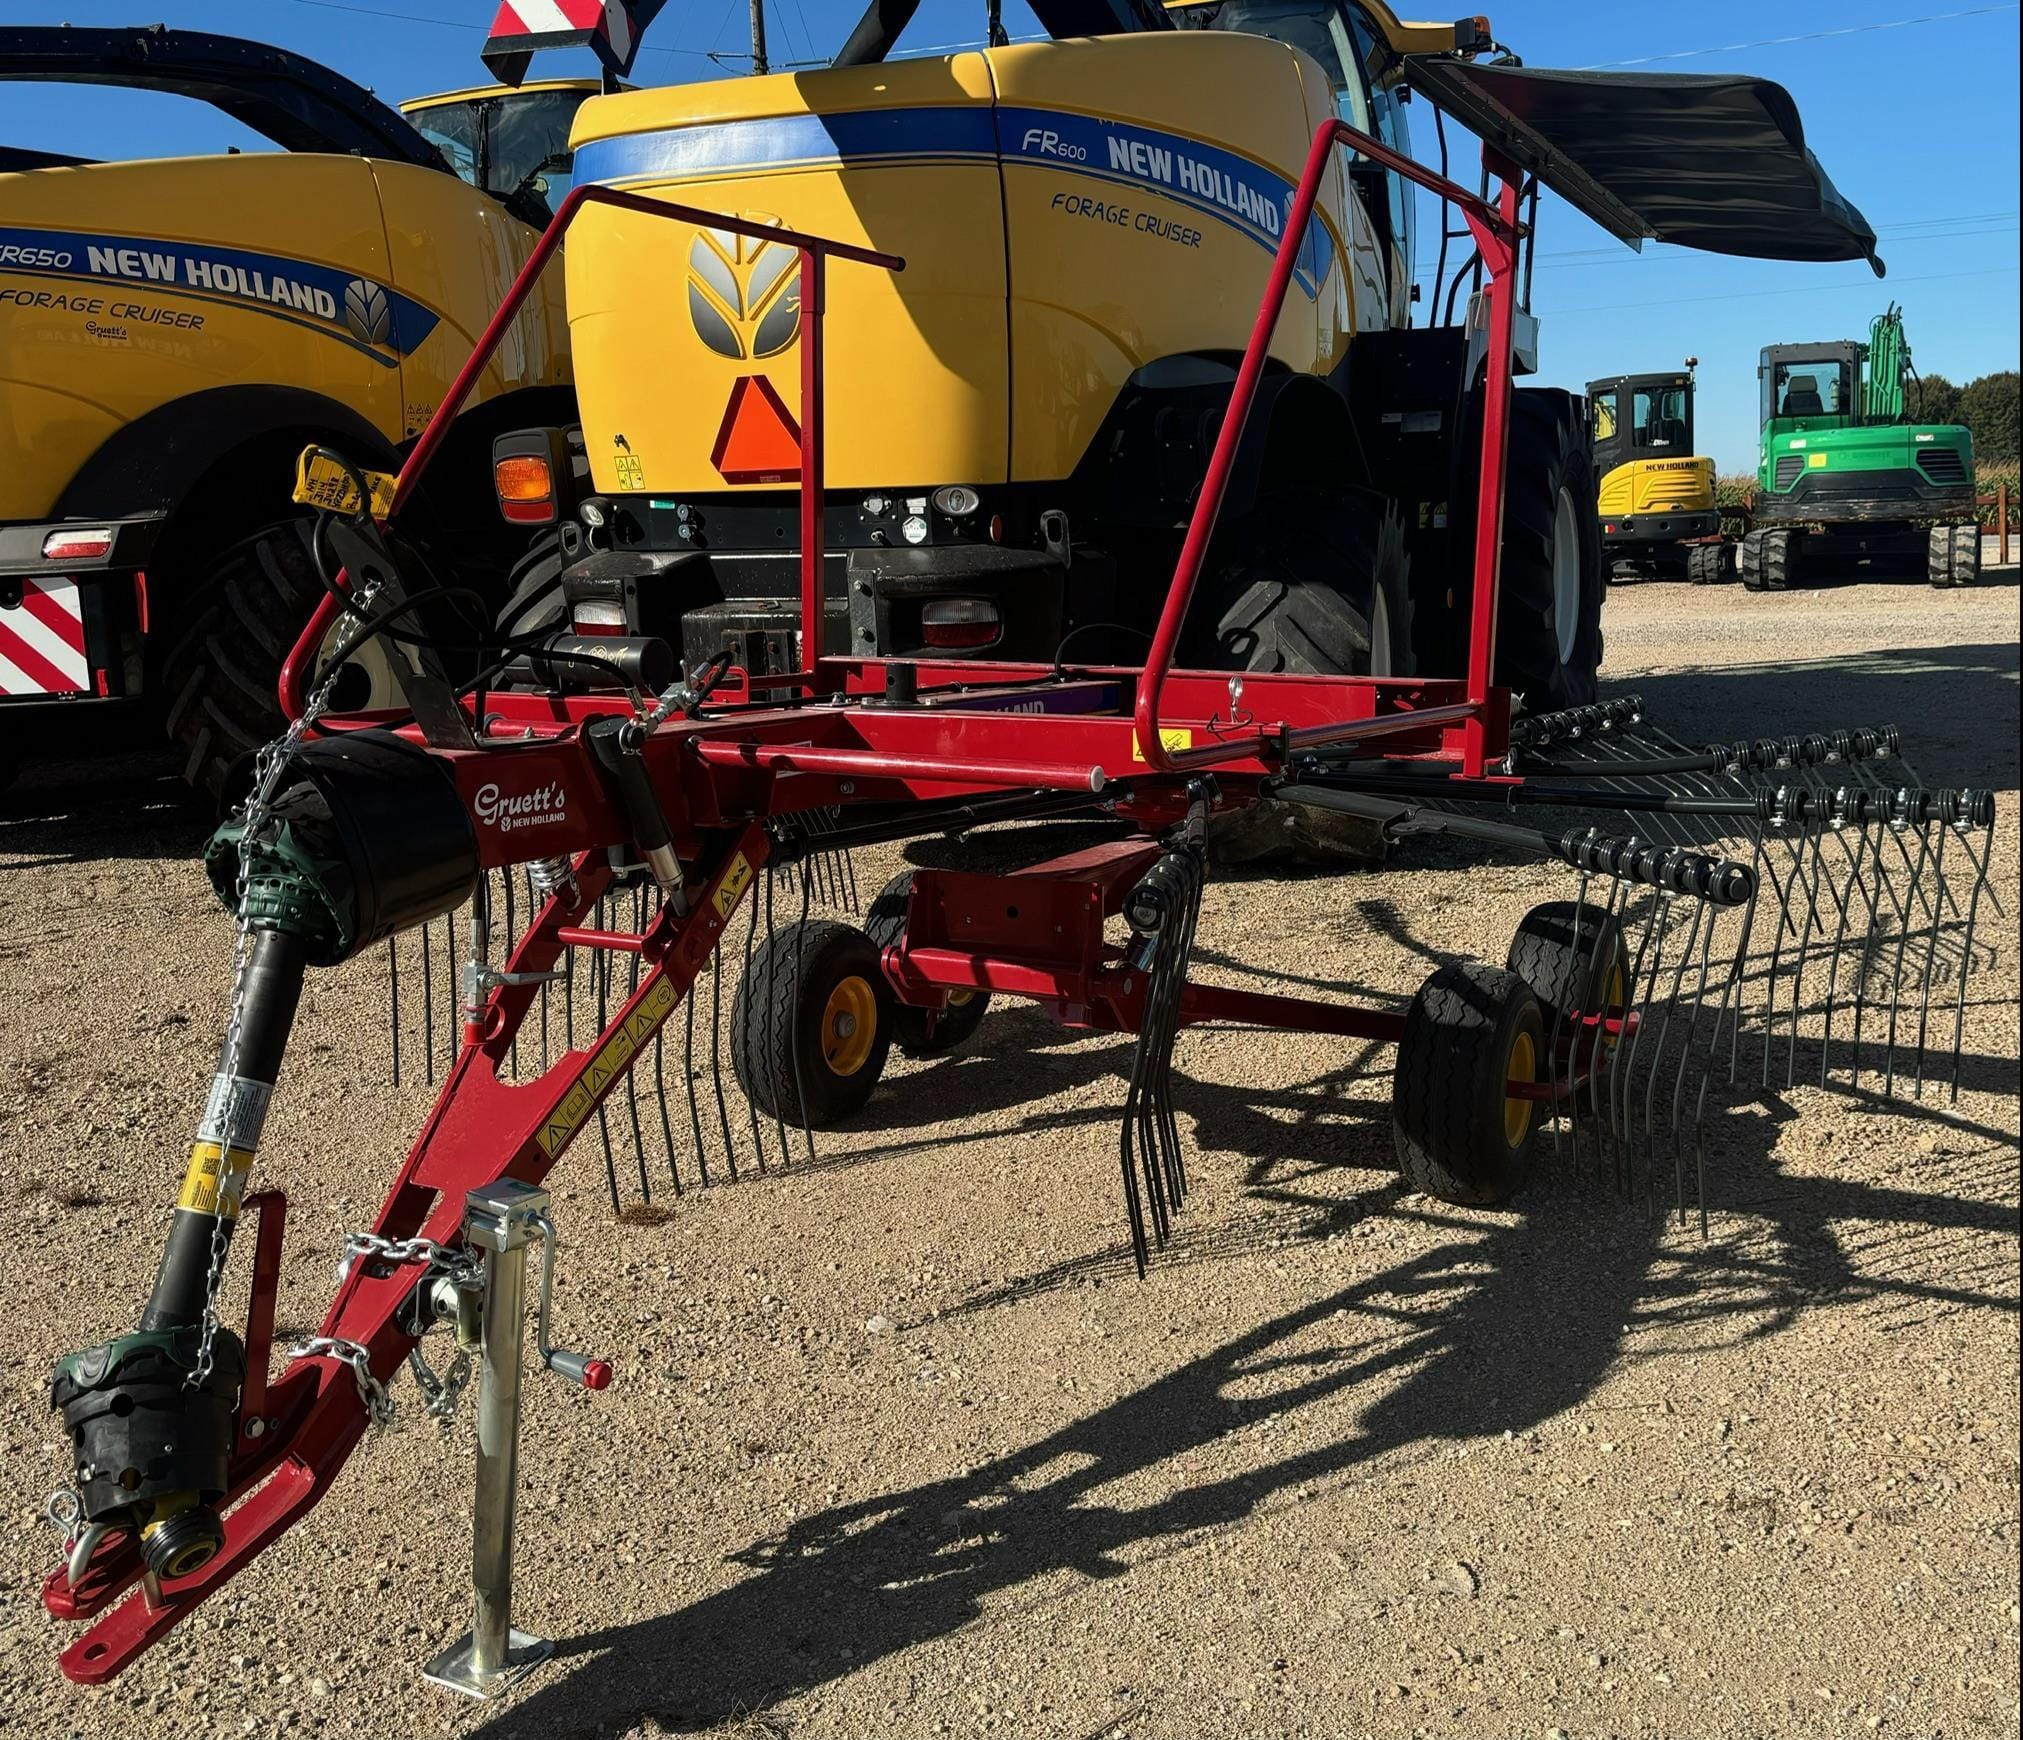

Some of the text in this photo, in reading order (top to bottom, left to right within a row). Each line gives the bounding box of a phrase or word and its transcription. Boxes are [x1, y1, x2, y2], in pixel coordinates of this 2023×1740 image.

[1106, 135, 1172, 184] NEW
[1176, 154, 1280, 236] HOLLAND
[1051, 193, 1202, 249] FORAGE CRUISER
[87, 246, 176, 282] NEW
[184, 258, 337, 320] HOLLAND
[0, 289, 205, 330] FORAGE CRUISER
[1645, 461, 1699, 472] NEW HOLLAND
[474, 780, 566, 826] Gruett's
[512, 811, 566, 829] NEW HOLLAND
